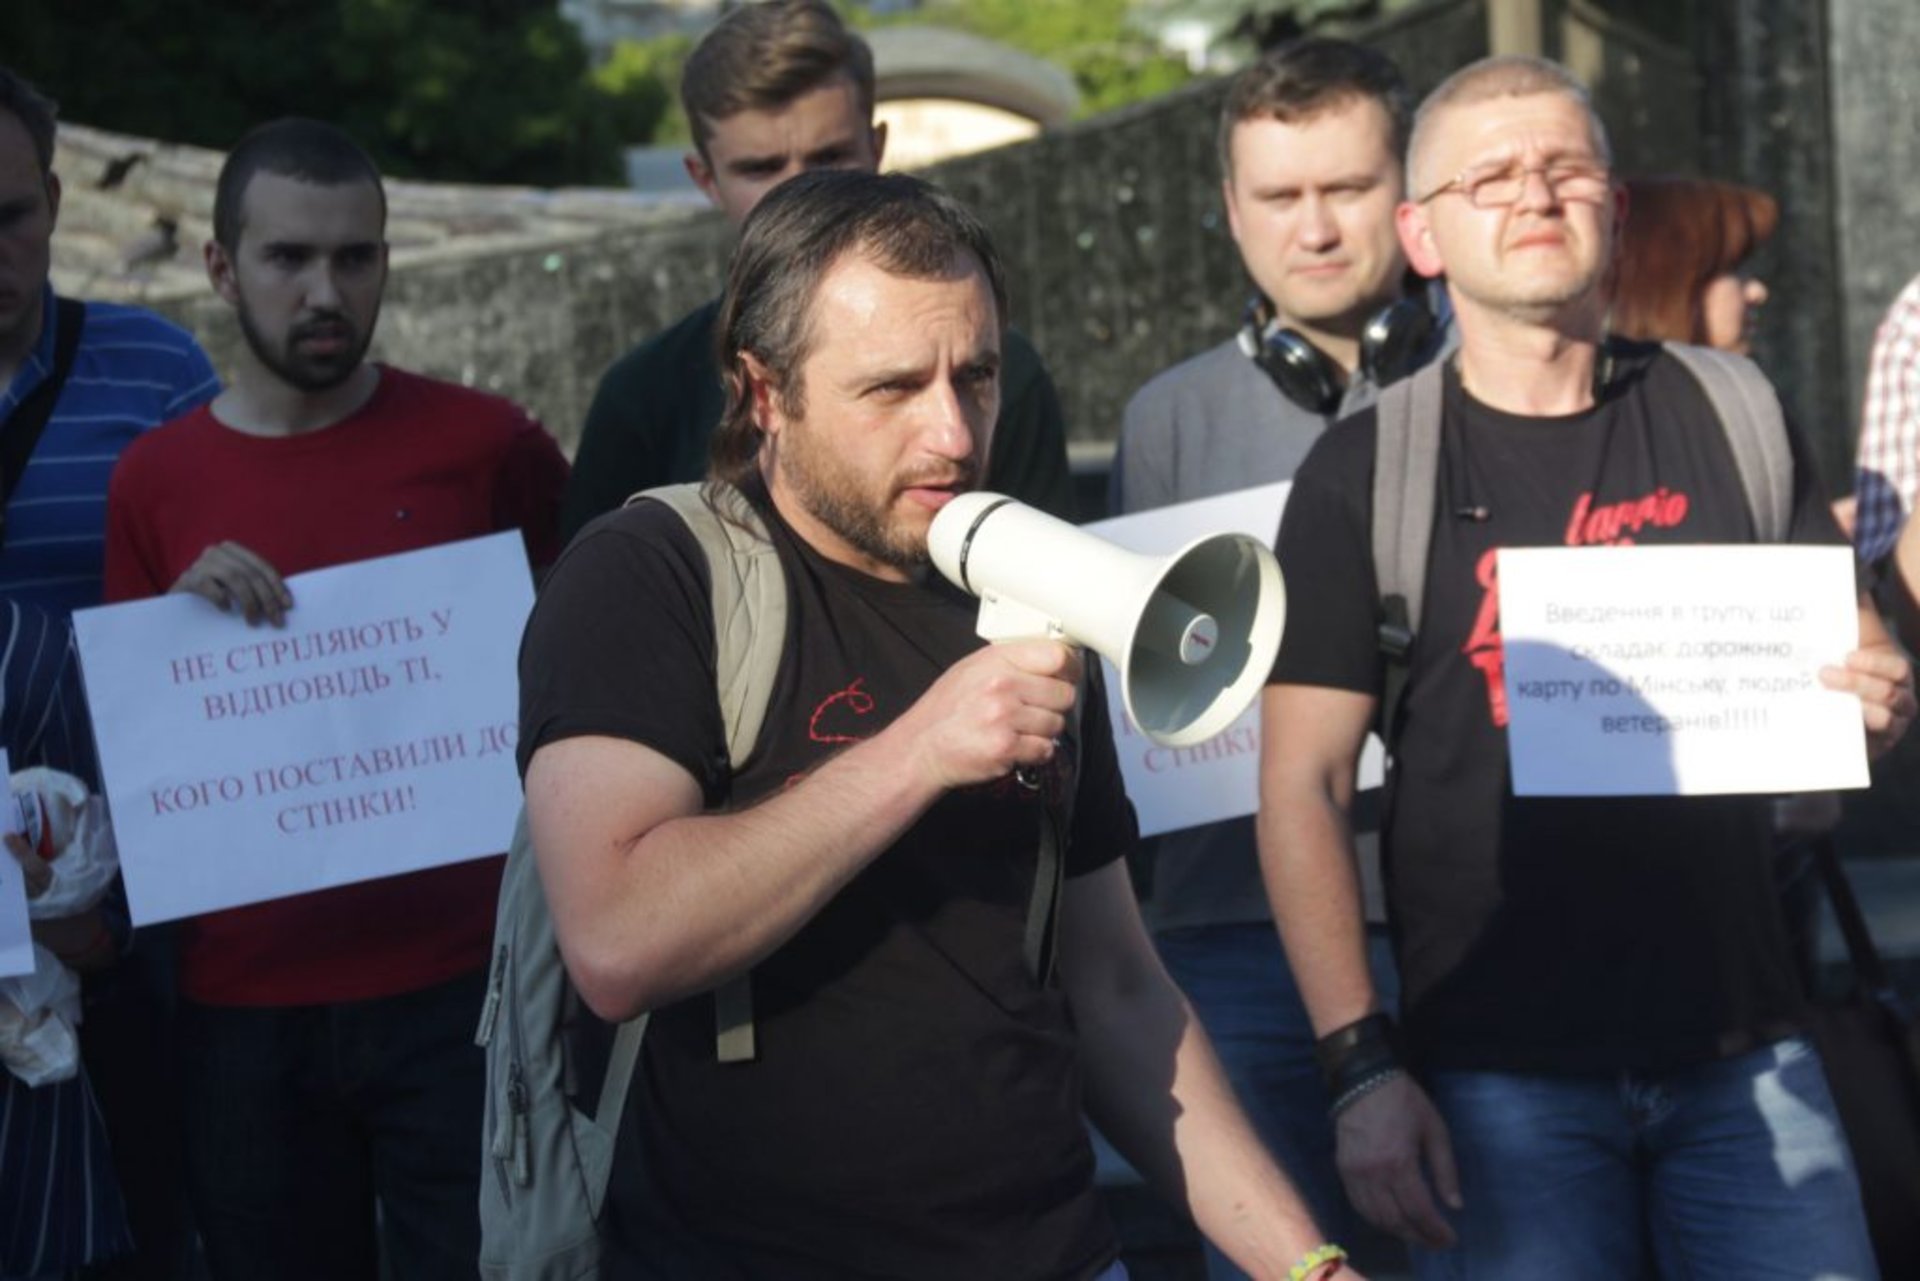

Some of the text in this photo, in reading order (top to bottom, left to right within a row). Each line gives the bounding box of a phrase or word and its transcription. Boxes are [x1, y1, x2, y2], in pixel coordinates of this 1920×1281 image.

[1545, 602, 1663, 625] Введення
[170, 608, 453, 686] НЕ СТРІЛЯЮТЬ У
[1675, 640, 1792, 661] дорожню
[203, 664, 391, 721] ВІДПОВІДЬ
[1517, 680, 1582, 703] карту
[1590, 680, 1620, 697] по
[150, 722, 518, 816] КОГО ПОСТАВИЛИ ДО
[276, 785, 417, 835] СТІНКИ!
